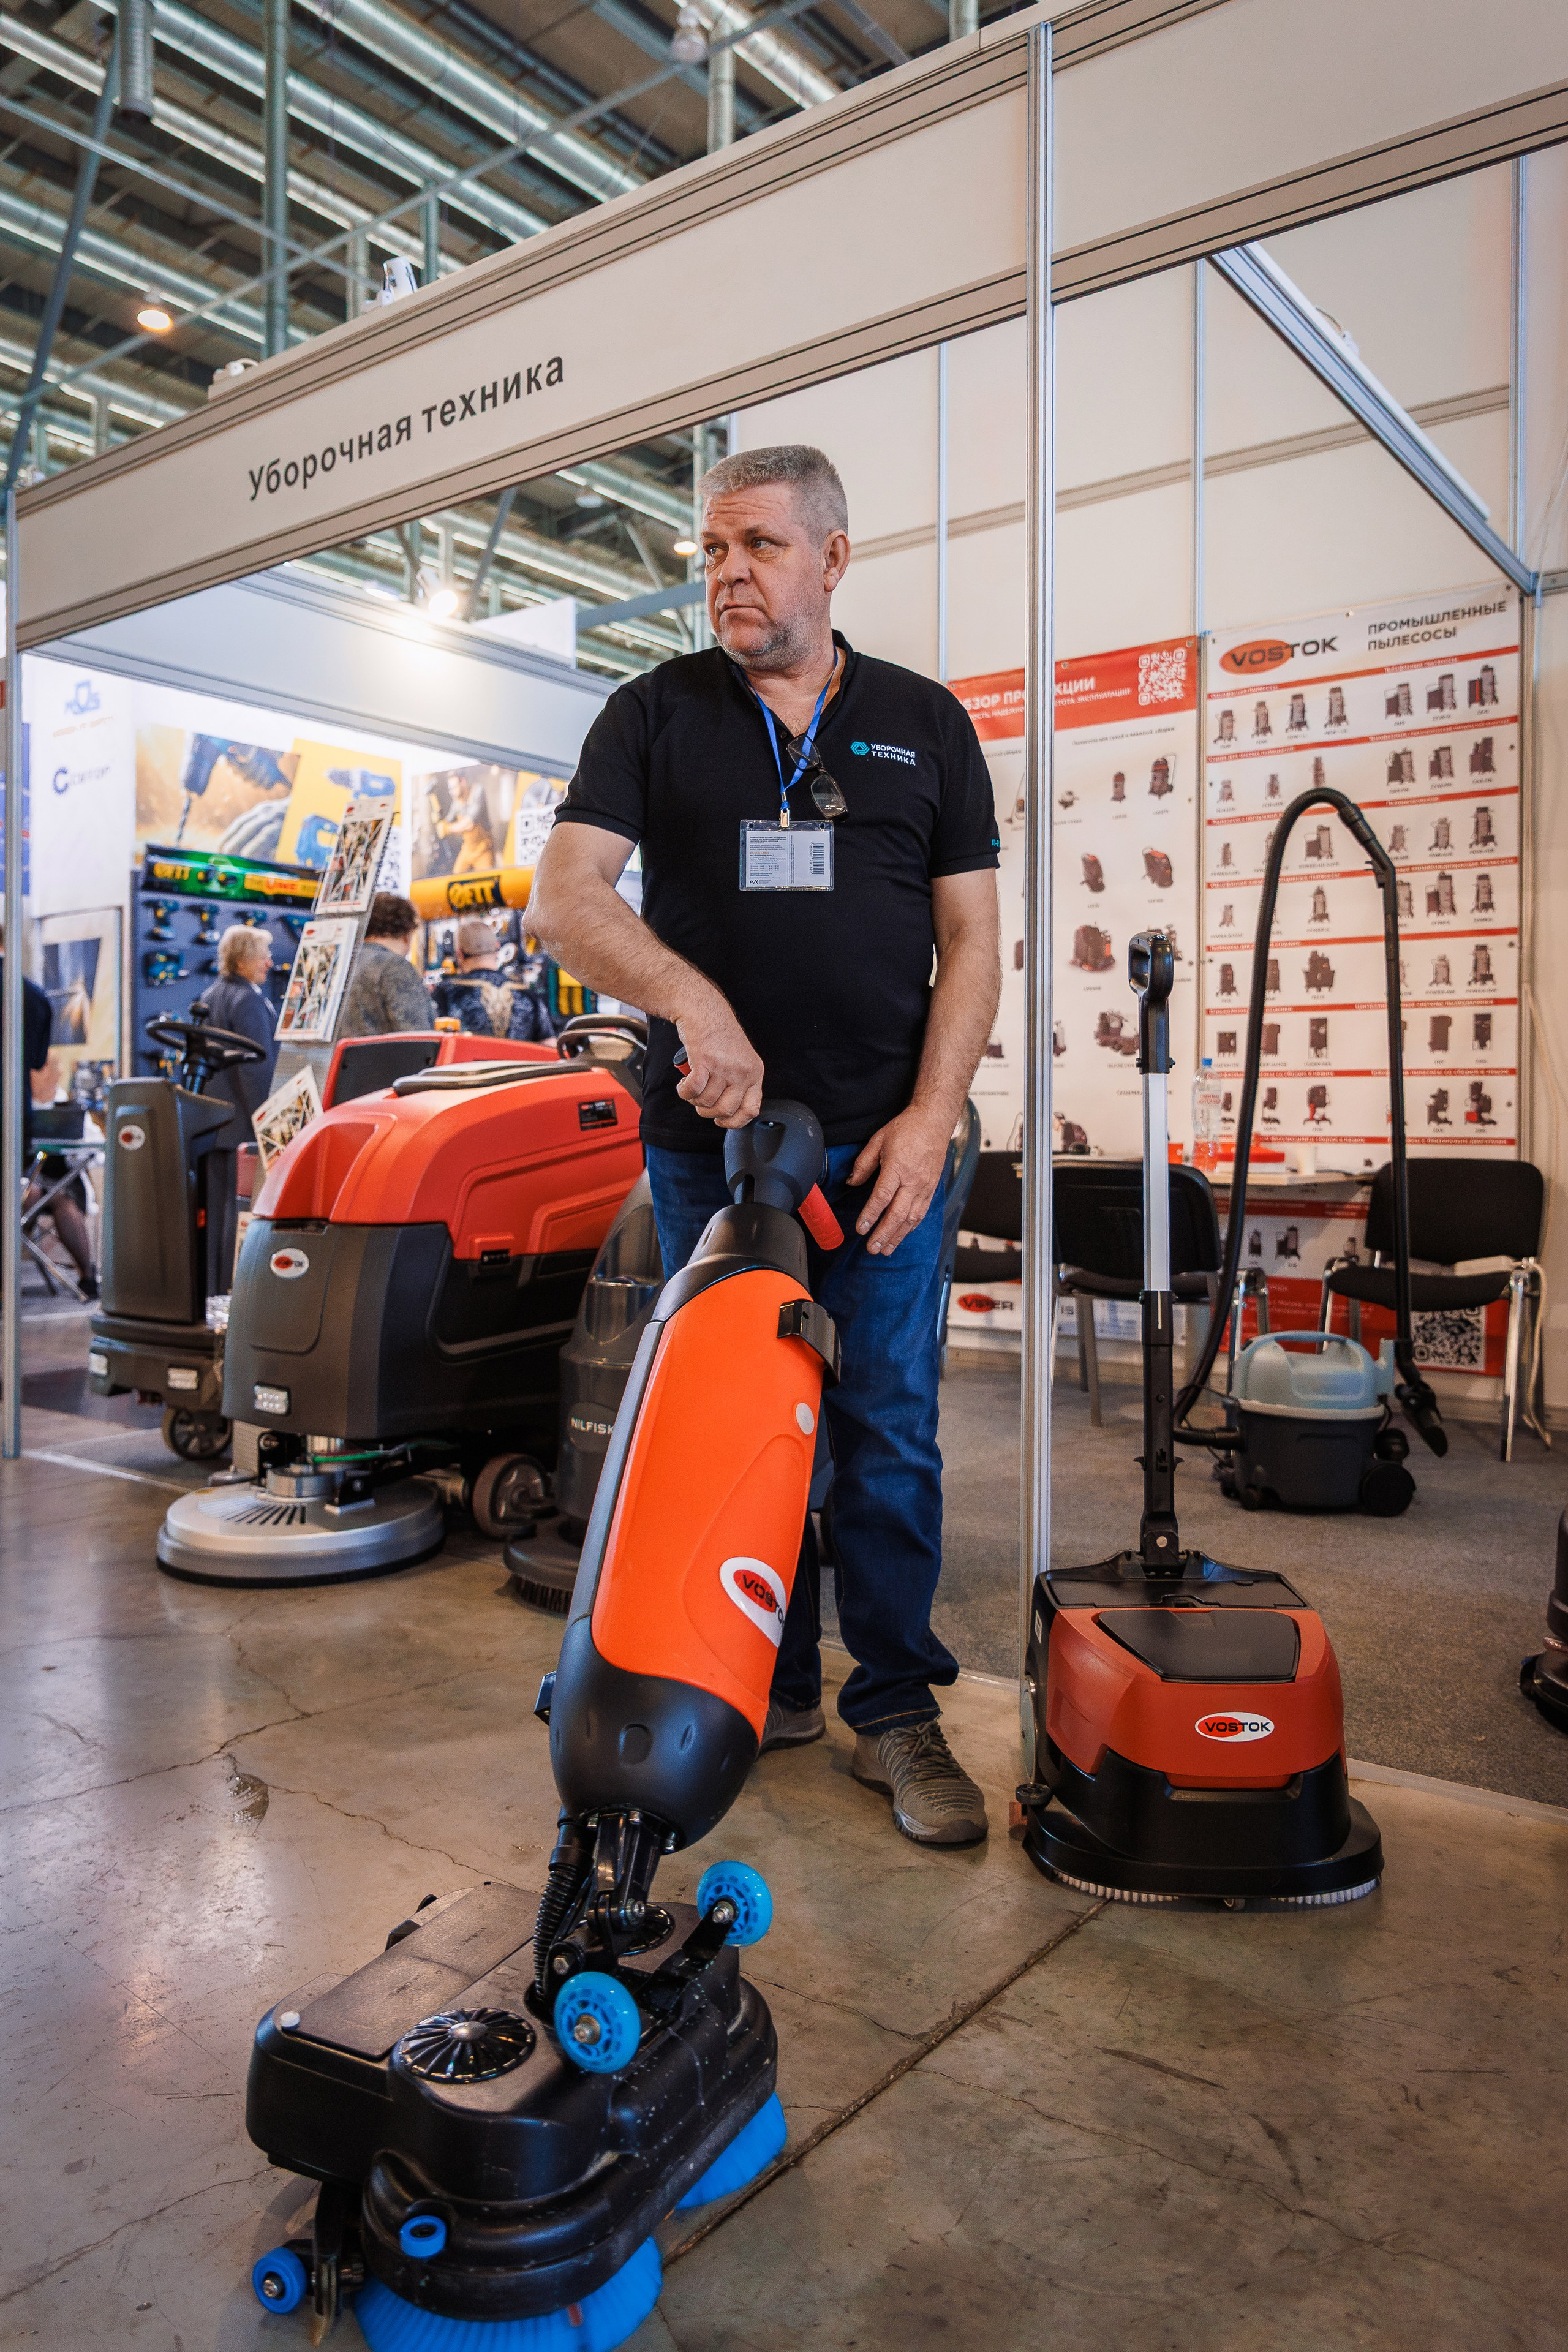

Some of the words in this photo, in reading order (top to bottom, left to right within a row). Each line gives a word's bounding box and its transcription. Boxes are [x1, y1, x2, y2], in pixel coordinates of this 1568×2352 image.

[249, 415, 411, 501] Уборочная
[421, 356, 564, 432] техника
[1366, 600, 1507, 636] ПРОМЫШЛЕННЫЕ
[1230, 636, 1339, 668] VOSTOK
[1366, 627, 1458, 652] ПЫЛЕСОСЫ
[870, 743, 916, 758] УБОРОЧНАЯ
[871, 751, 916, 766] ТЕХНИКА
[571, 1417, 615, 1435] NILFISK
[742, 1574, 785, 1627] VOSTO
[1205, 1722, 1270, 1732] VOSTOK
